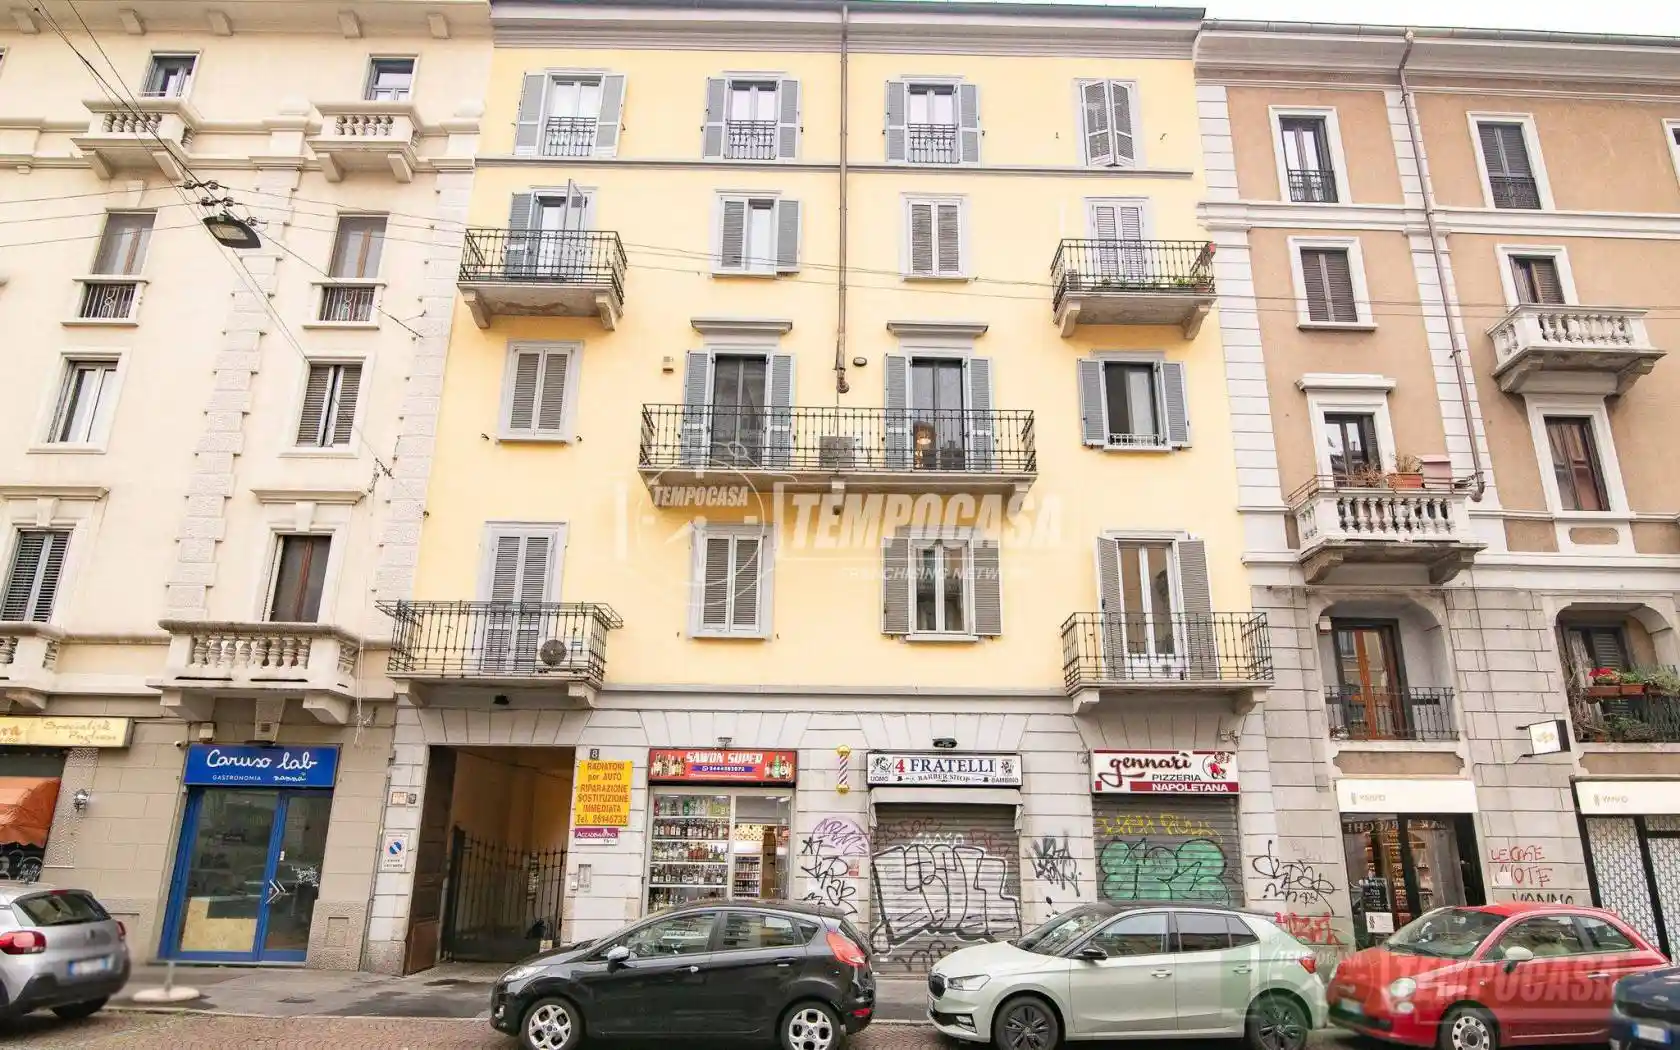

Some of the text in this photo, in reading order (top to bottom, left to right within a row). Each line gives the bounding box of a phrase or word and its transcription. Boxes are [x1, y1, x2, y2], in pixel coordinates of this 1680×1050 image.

[207, 749, 317, 770] Caruso lab
[587, 762, 625, 771] RADIATORI
[895, 759, 995, 773] 4 FRATELLI
[588, 773, 622, 782] per AUTO
[918, 774, 948, 782] BARBER
[1152, 774, 1201, 782] PIZZERIA
[580, 784, 629, 793] RIPARAZIONE
[1152, 783, 1228, 792] NAPOLETANA
[577, 794, 629, 803] SOSTITUZIONE
[583, 804, 622, 813] IMMEDIATA
